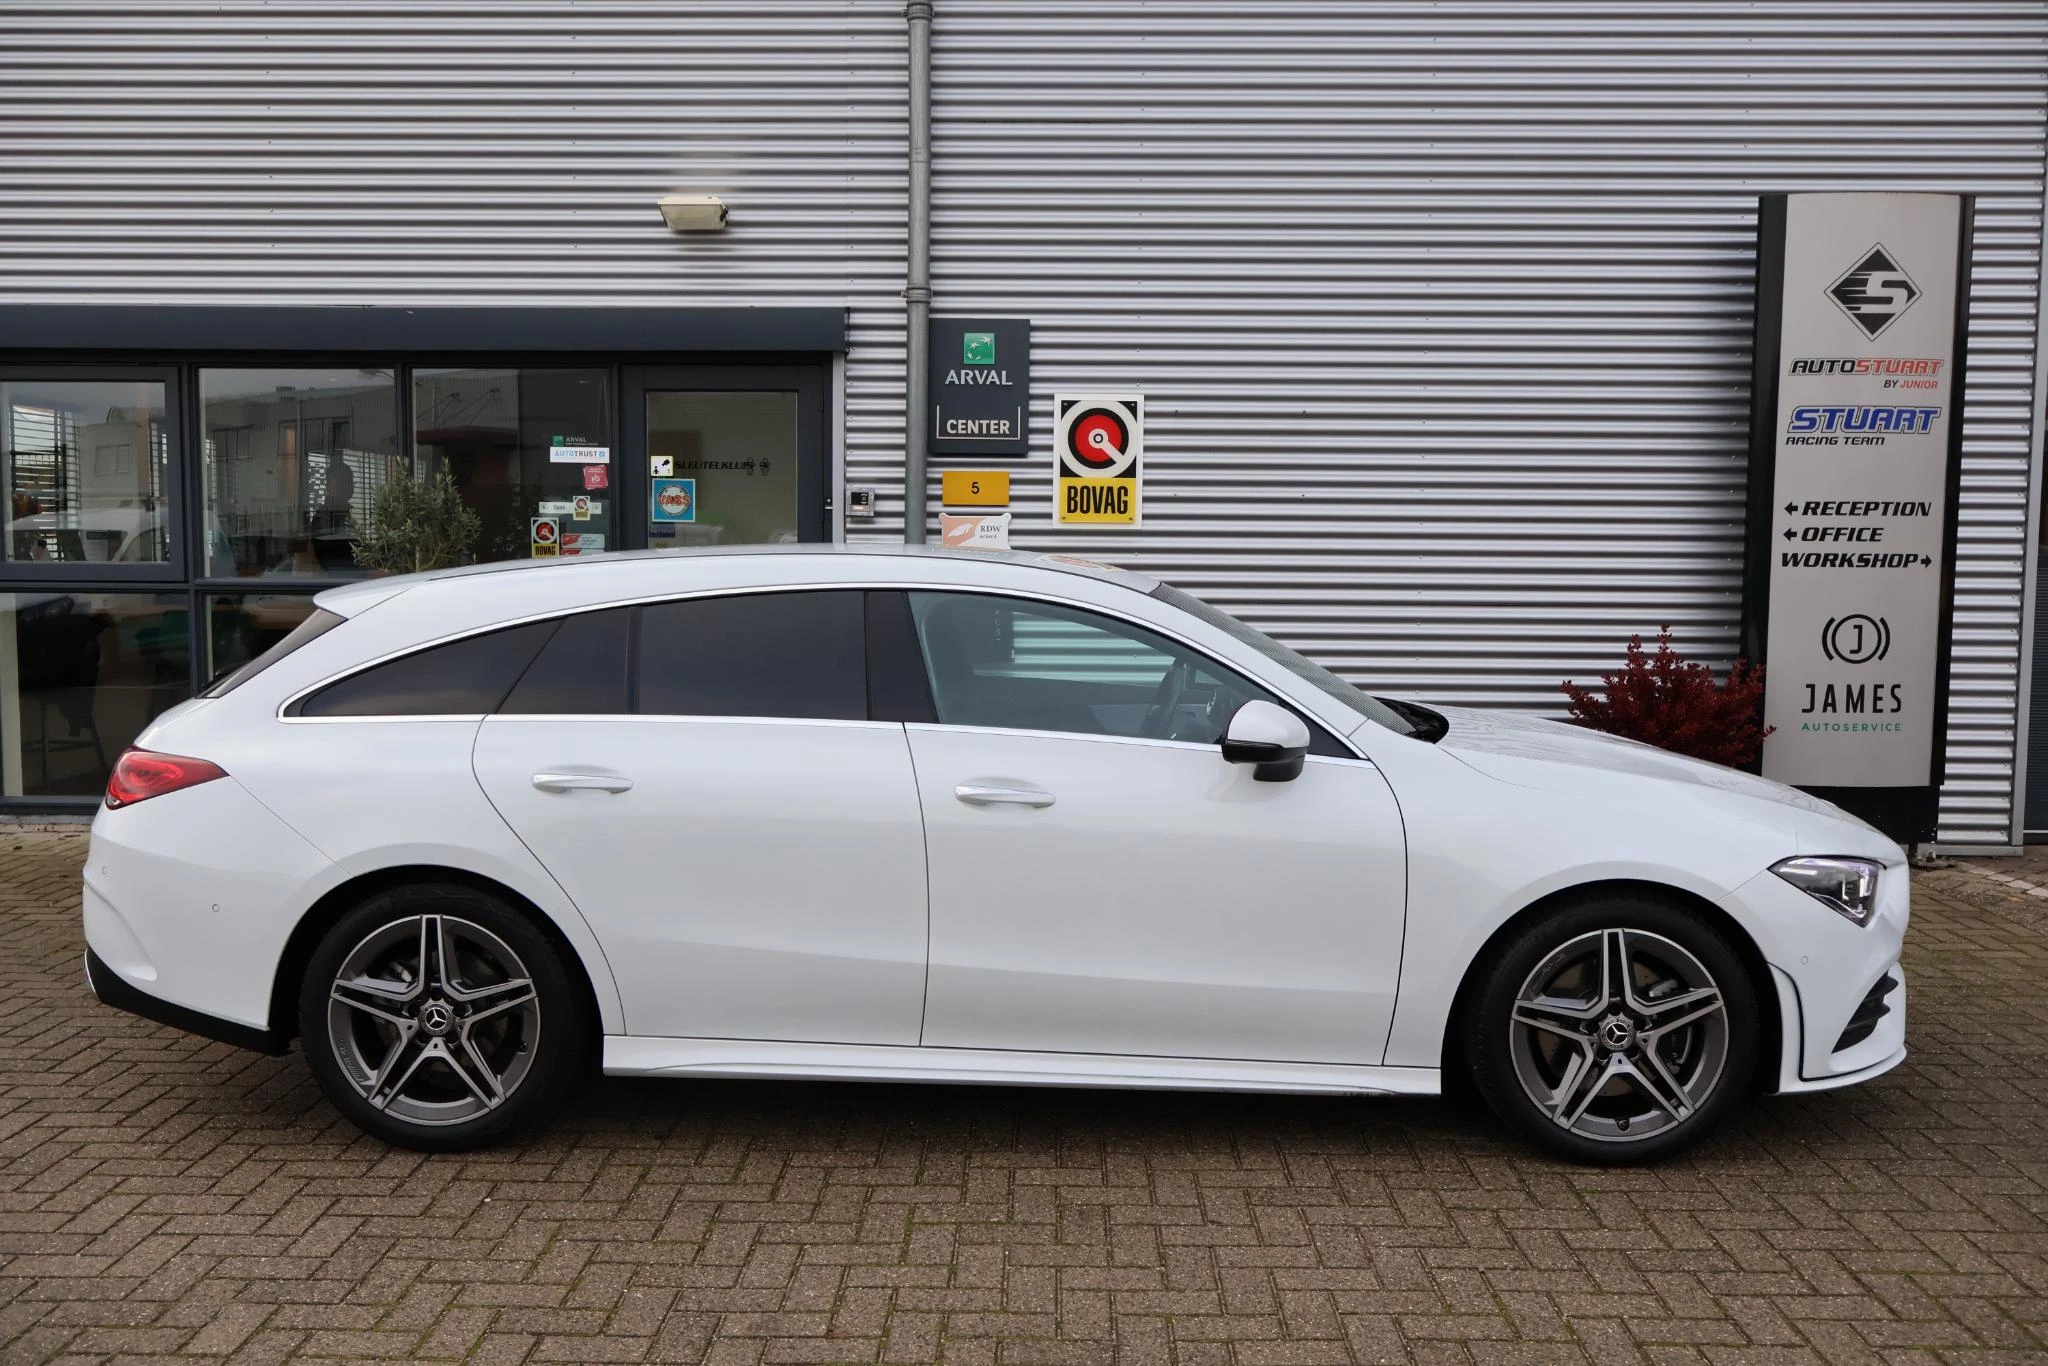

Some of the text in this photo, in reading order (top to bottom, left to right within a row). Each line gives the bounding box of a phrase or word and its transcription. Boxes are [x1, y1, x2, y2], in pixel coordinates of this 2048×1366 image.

[1789, 358, 1944, 376] AUTOSTUART
[944, 369, 1013, 386] ARVAL
[1883, 379, 1938, 390] BY JUNIOR
[946, 419, 1010, 435] CENTER
[1788, 406, 1942, 434] STUART
[1785, 436, 1885, 446] RACING TEAM
[554, 450, 597, 458] AUTOTRUST
[971, 481, 980, 494] 5
[1066, 485, 1129, 515] BOVAG
[1801, 501, 1932, 517] RECEPTION
[980, 525, 1001, 533] RDW
[1801, 527, 1884, 542] OFFICE
[535, 545, 556, 556] BOVAG
[1781, 552, 1919, 568] WORKSHOP
[1849, 624, 1863, 655] J
[1801, 683, 1903, 714] JAMES
[1801, 722, 1902, 733] AUTOSERVICE
